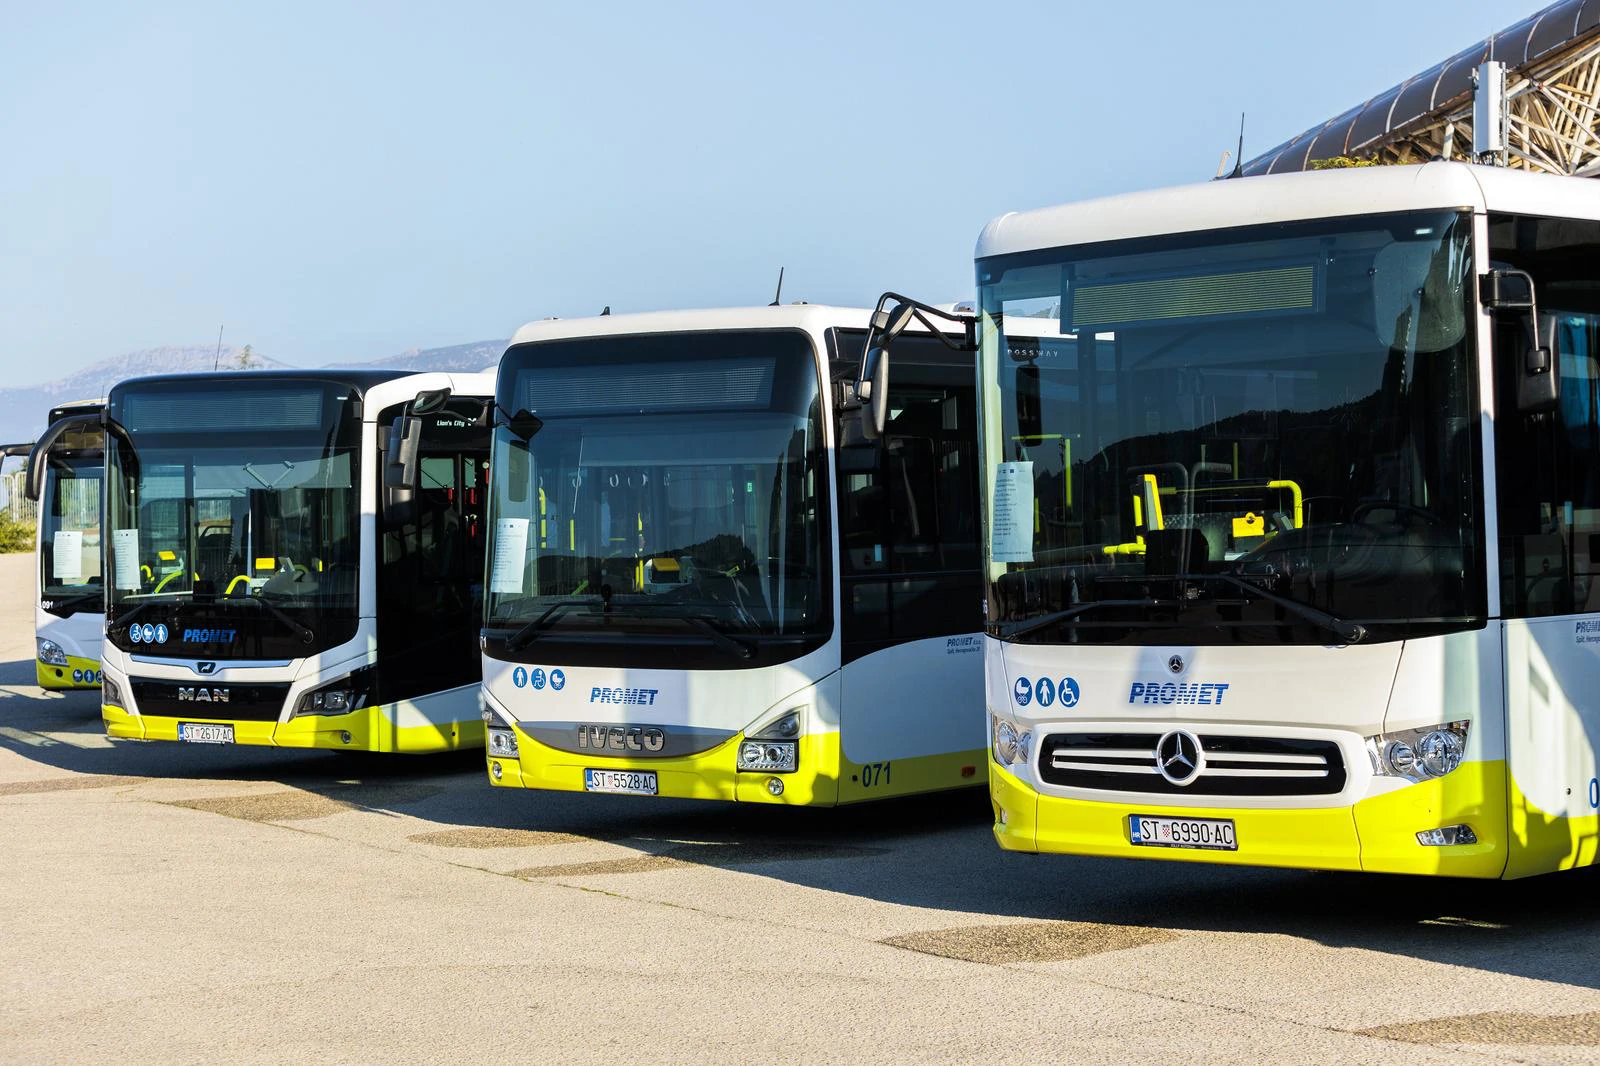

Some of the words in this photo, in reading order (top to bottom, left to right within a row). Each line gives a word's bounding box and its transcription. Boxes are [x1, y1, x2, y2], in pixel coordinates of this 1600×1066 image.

[183, 629, 237, 643] PROMET
[946, 636, 973, 647] PROMET
[178, 687, 230, 703] MAN
[590, 687, 659, 706] PROMET
[1129, 682, 1230, 705] PROMET
[184, 726, 194, 738] ST
[578, 724, 665, 752] IVECO
[593, 772, 606, 787] ST
[862, 760, 891, 788] 071
[1141, 820, 1159, 840] ST
